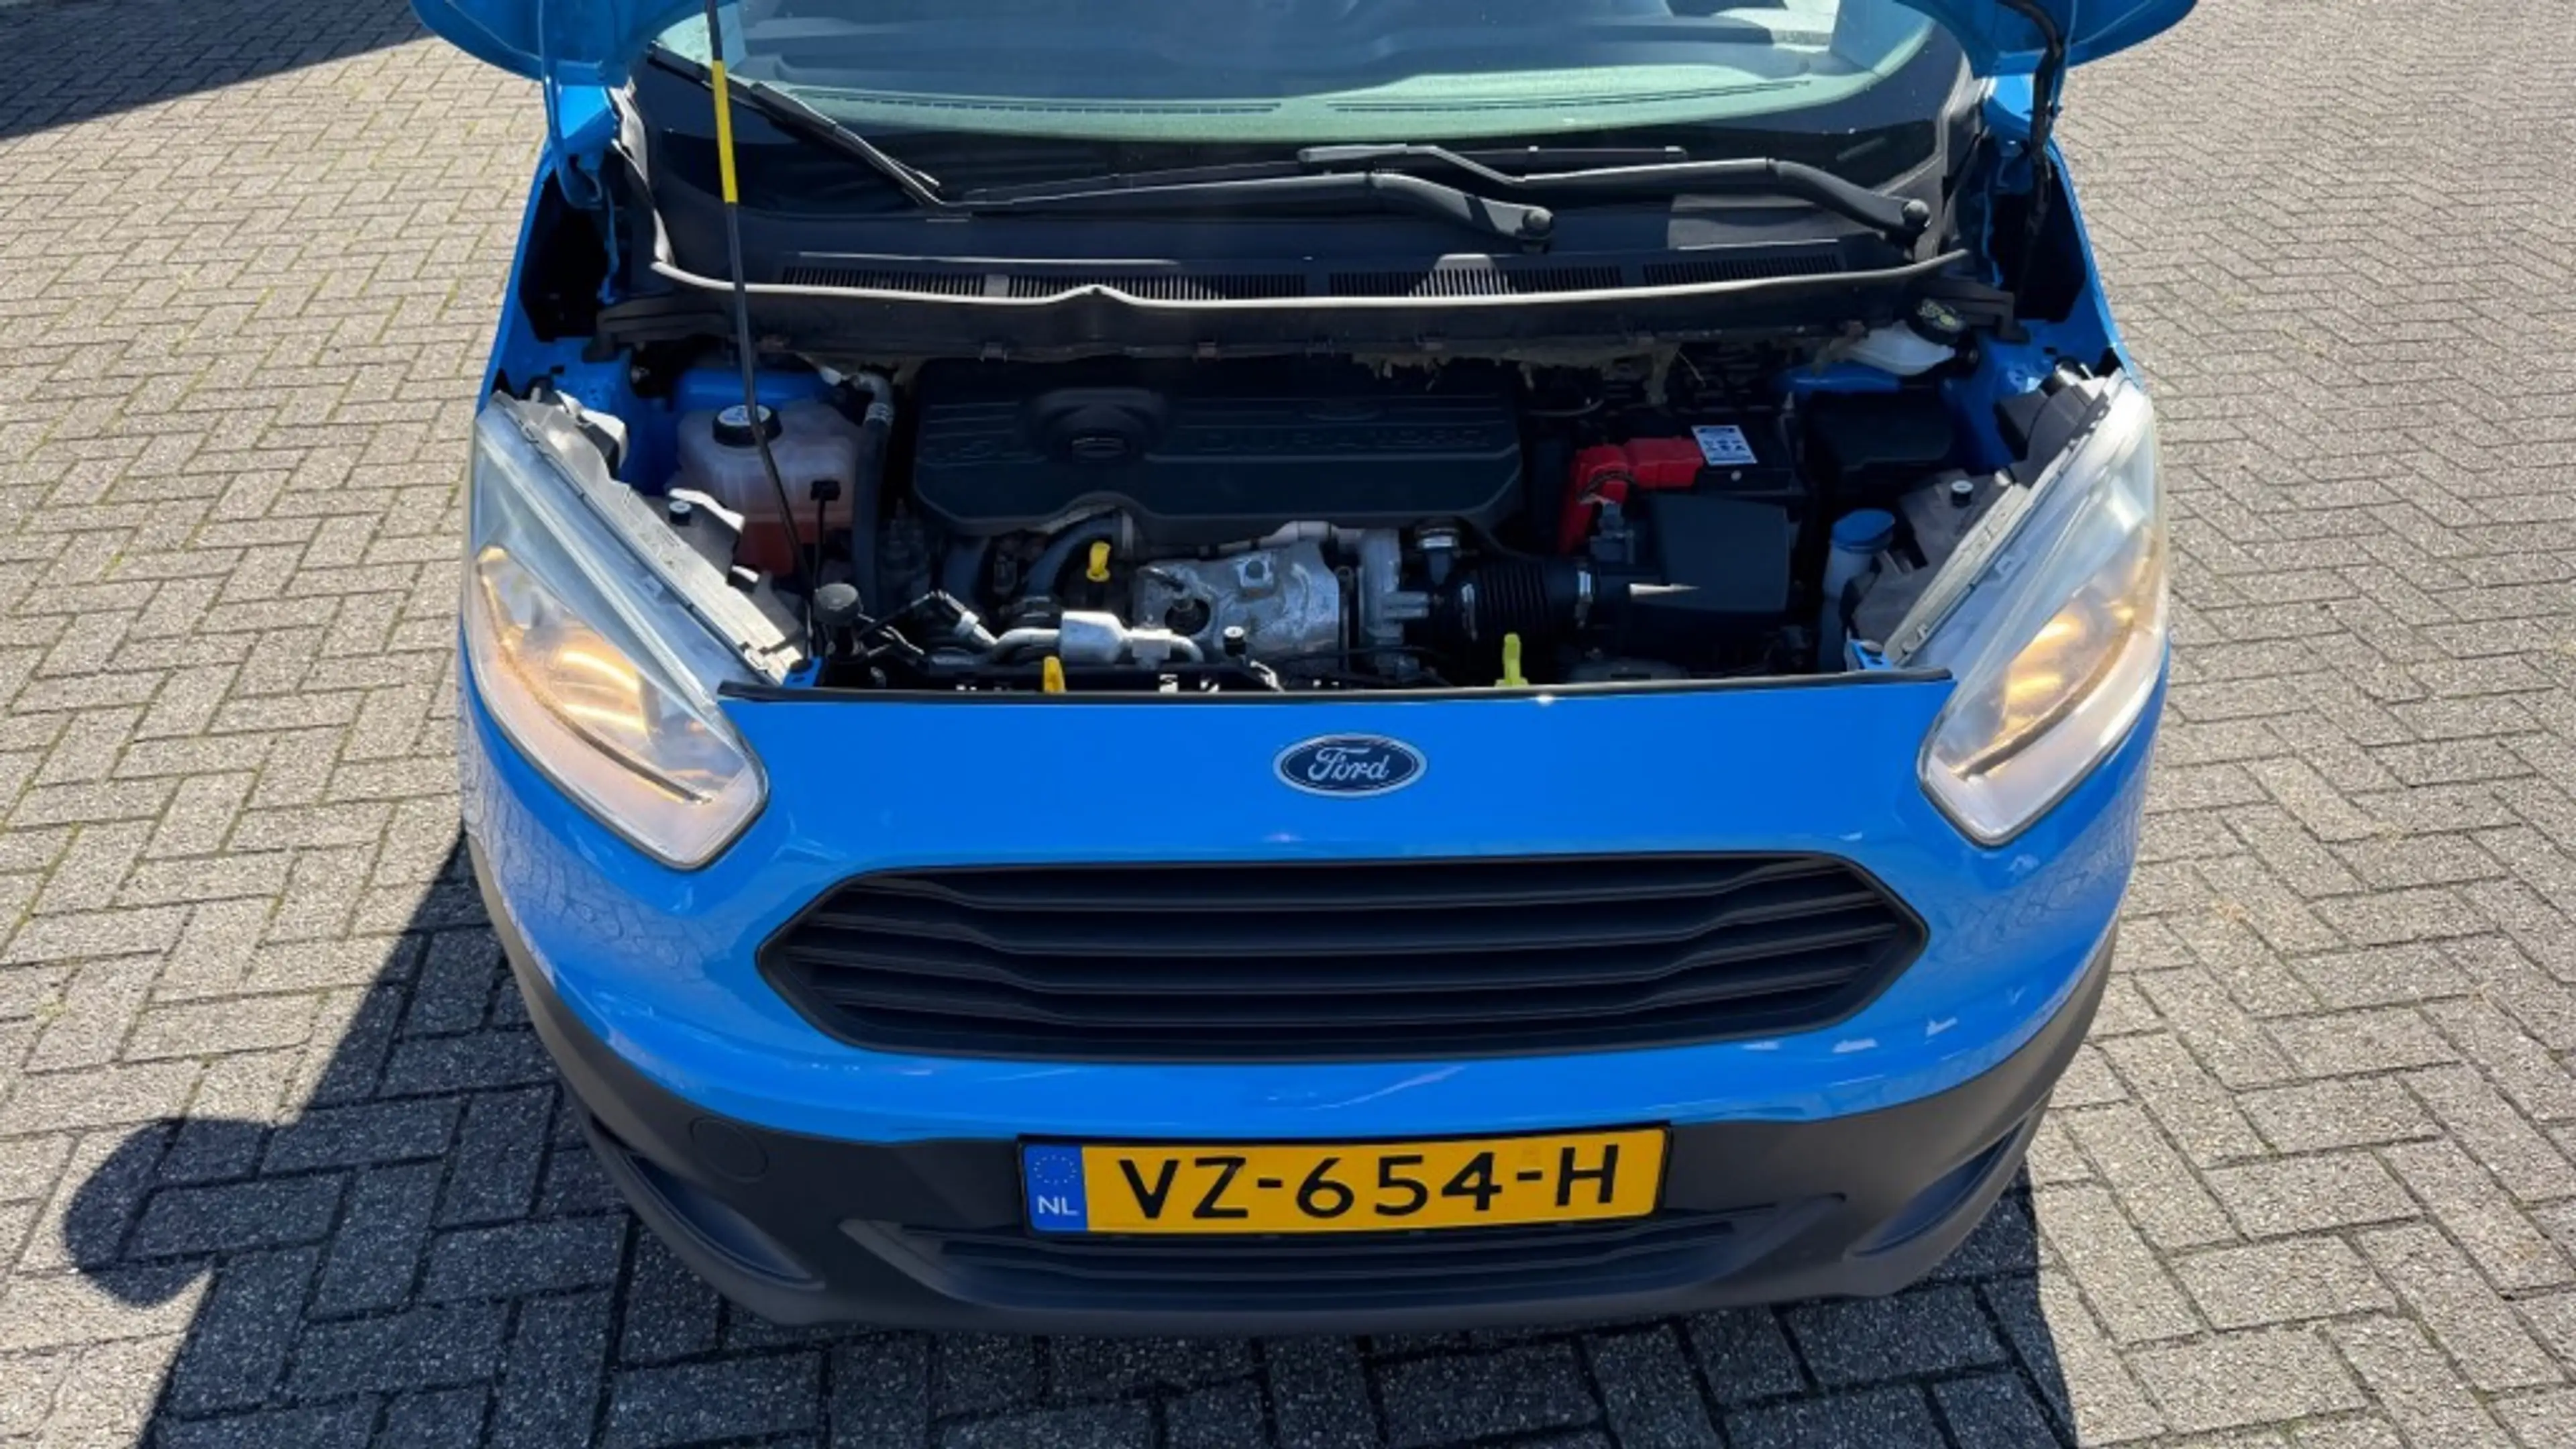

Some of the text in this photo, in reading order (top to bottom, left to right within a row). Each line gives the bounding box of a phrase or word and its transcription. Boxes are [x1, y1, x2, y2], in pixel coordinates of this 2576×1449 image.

[1307, 747, 1390, 781] Ford
[1118, 1144, 1619, 1220] VZ-654-H
[1037, 1195, 1079, 1216] NL
